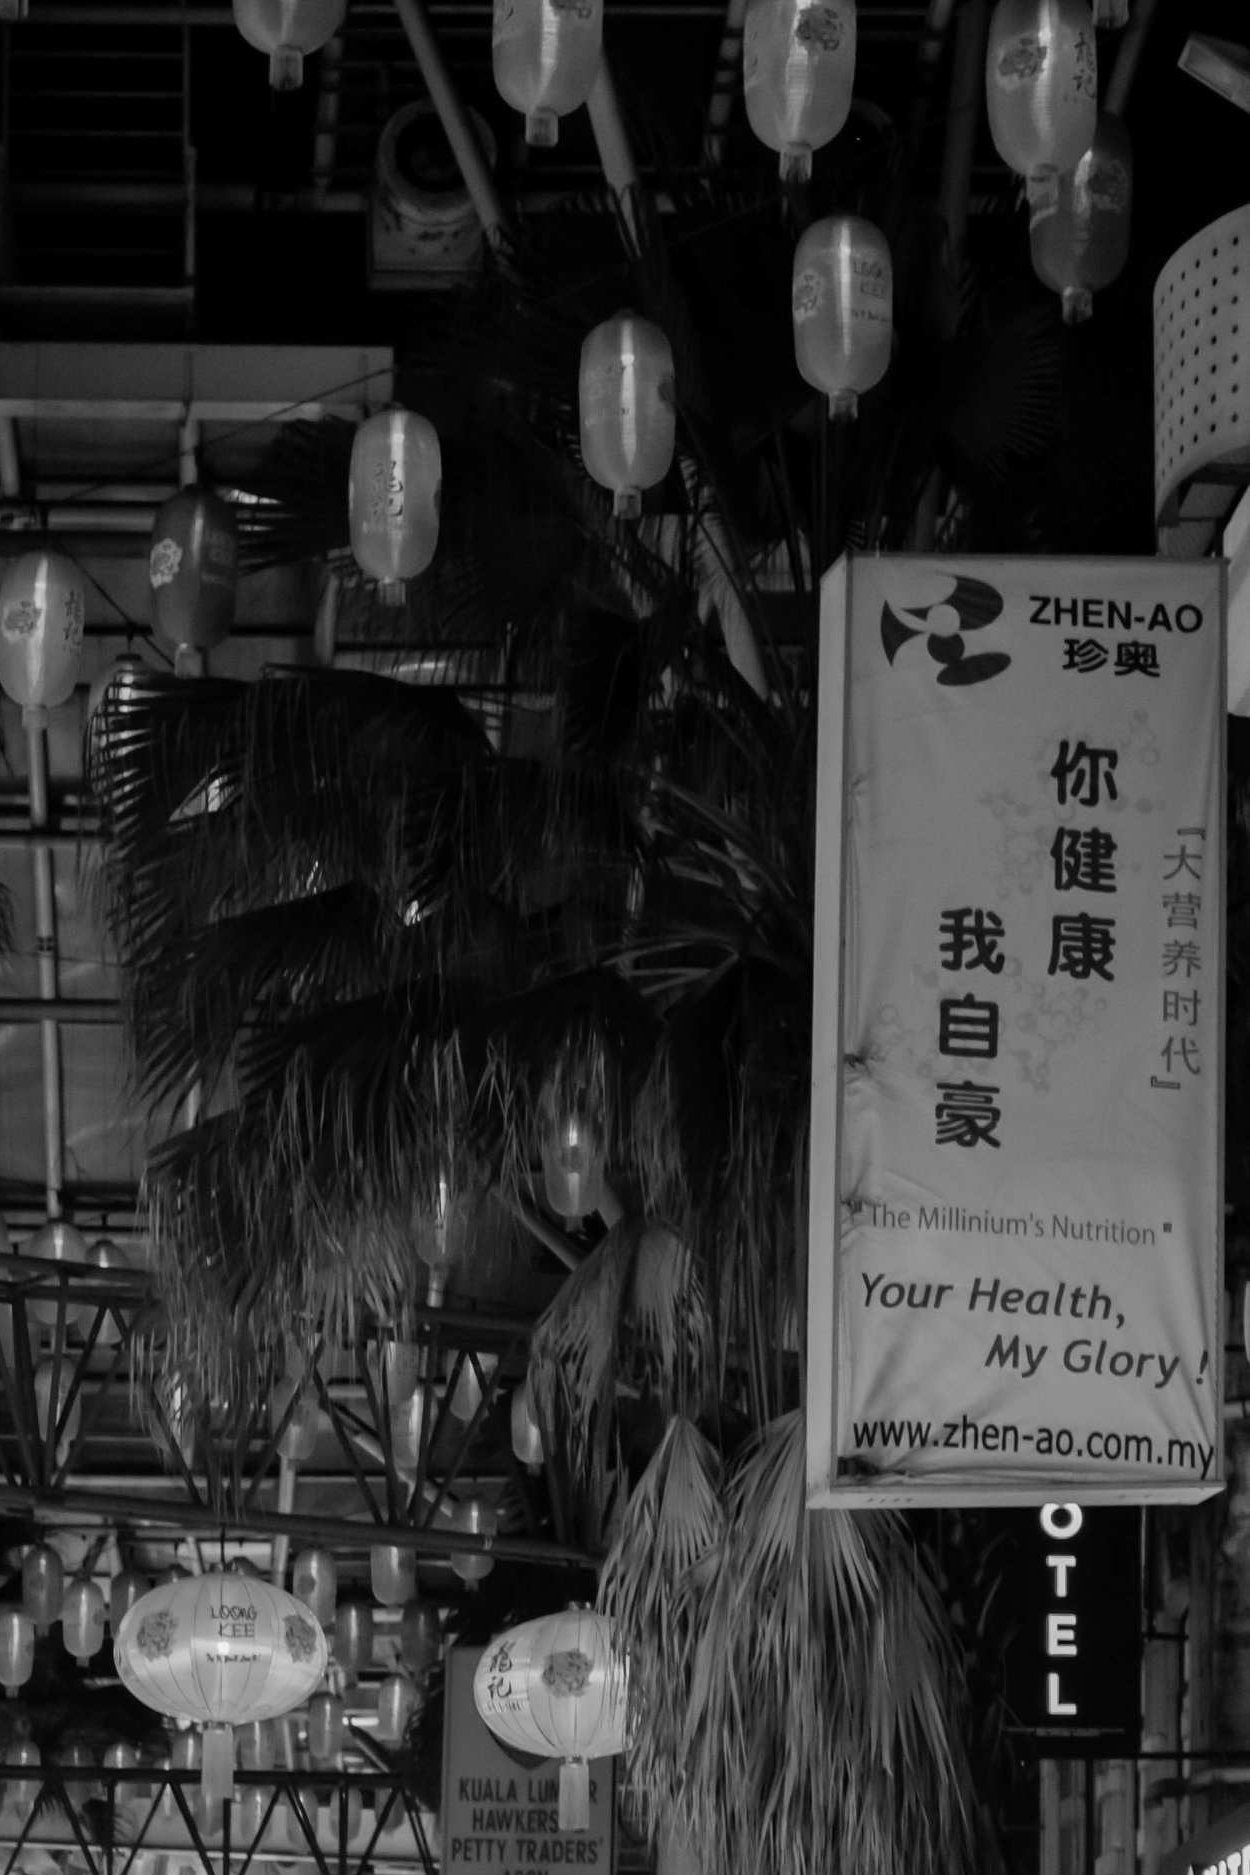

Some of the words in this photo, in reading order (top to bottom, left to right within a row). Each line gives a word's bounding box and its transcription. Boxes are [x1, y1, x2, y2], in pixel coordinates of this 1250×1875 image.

[1029, 595, 1204, 633] ZHEN-AO
[1062, 638, 1160, 678] 珍奥
[1047, 739, 1119, 981] 你健康
[935, 907, 1006, 1149] 我自豪
[918, 1206, 1045, 1238] Millinium's
[861, 1272, 954, 1309] Your
[968, 1277, 1126, 1329] Health,
[984, 1334, 1049, 1379] My
[853, 1415, 1215, 1480] www.zhen-ao.com.my
[210, 1604, 257, 1620] LOONG
[218, 1621, 255, 1638] KEE
[459, 1778, 518, 1802] KUALA
[452, 1837, 507, 1862] PETTY
